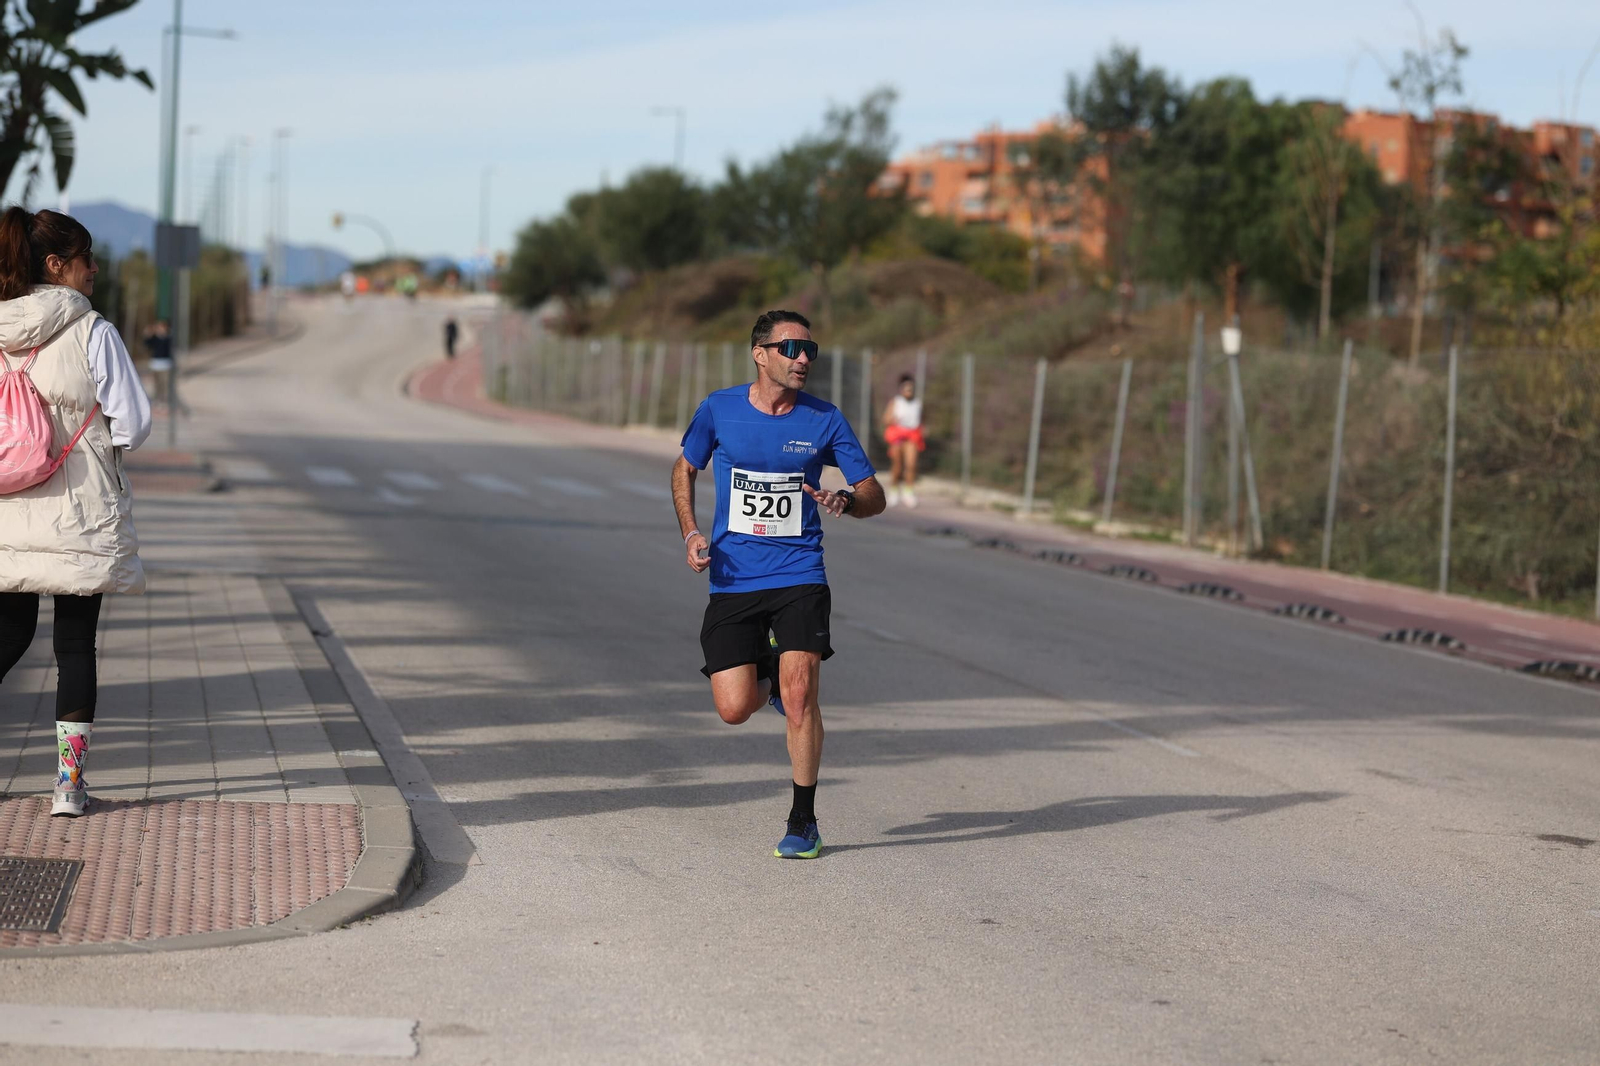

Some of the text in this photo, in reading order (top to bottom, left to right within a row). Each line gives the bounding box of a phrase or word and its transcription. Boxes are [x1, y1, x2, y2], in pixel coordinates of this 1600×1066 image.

[783, 445, 793, 453] RUN
[735, 479, 766, 492] UMA
[742, 494, 792, 518] 520
[753, 526, 766, 534] WE
